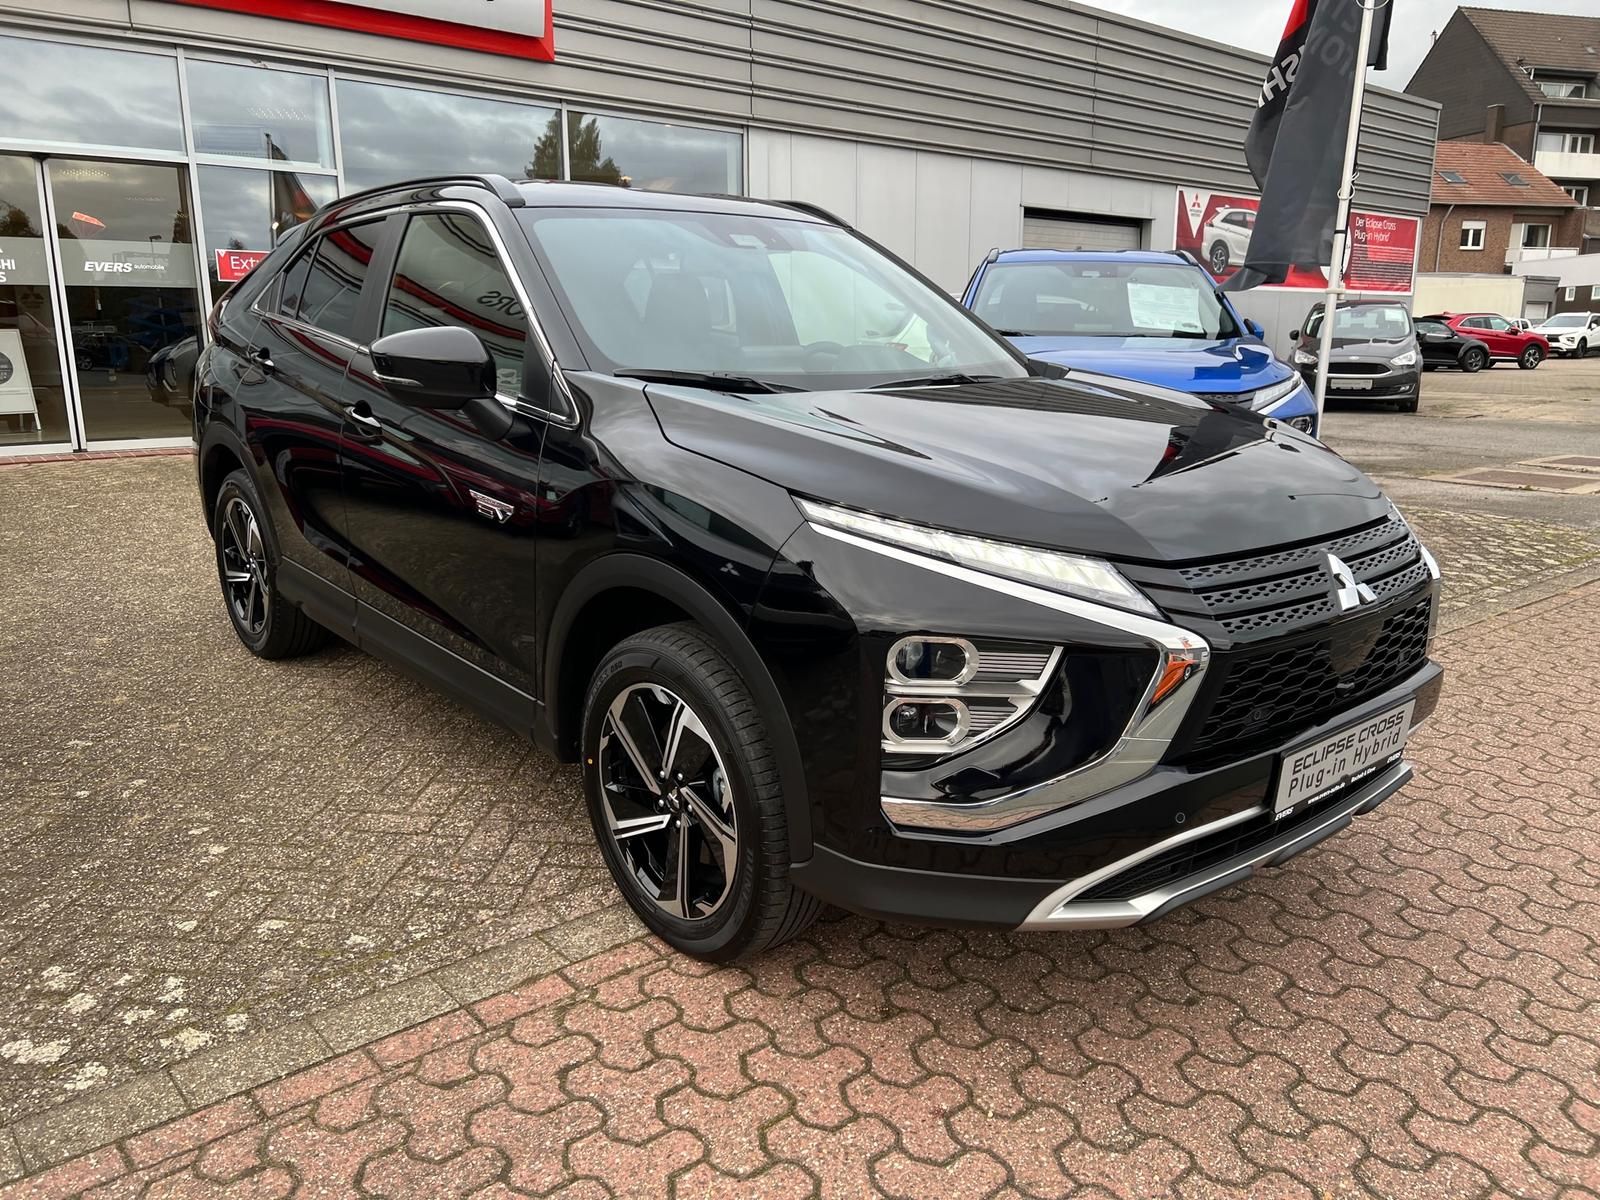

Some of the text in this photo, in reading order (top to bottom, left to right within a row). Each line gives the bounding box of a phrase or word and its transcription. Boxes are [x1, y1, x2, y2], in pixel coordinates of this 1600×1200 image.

[1355, 216, 1397, 231] Der Eclipse Cross
[1354, 229, 1391, 243] Plug-in Hybrid
[84, 261, 133, 273] EVERS
[1292, 733, 1355, 776] ECLIPSE
[1357, 710, 1405, 743] CROSS
[1288, 757, 1346, 798] Plug-in
[1352, 728, 1401, 766] Hybrid
